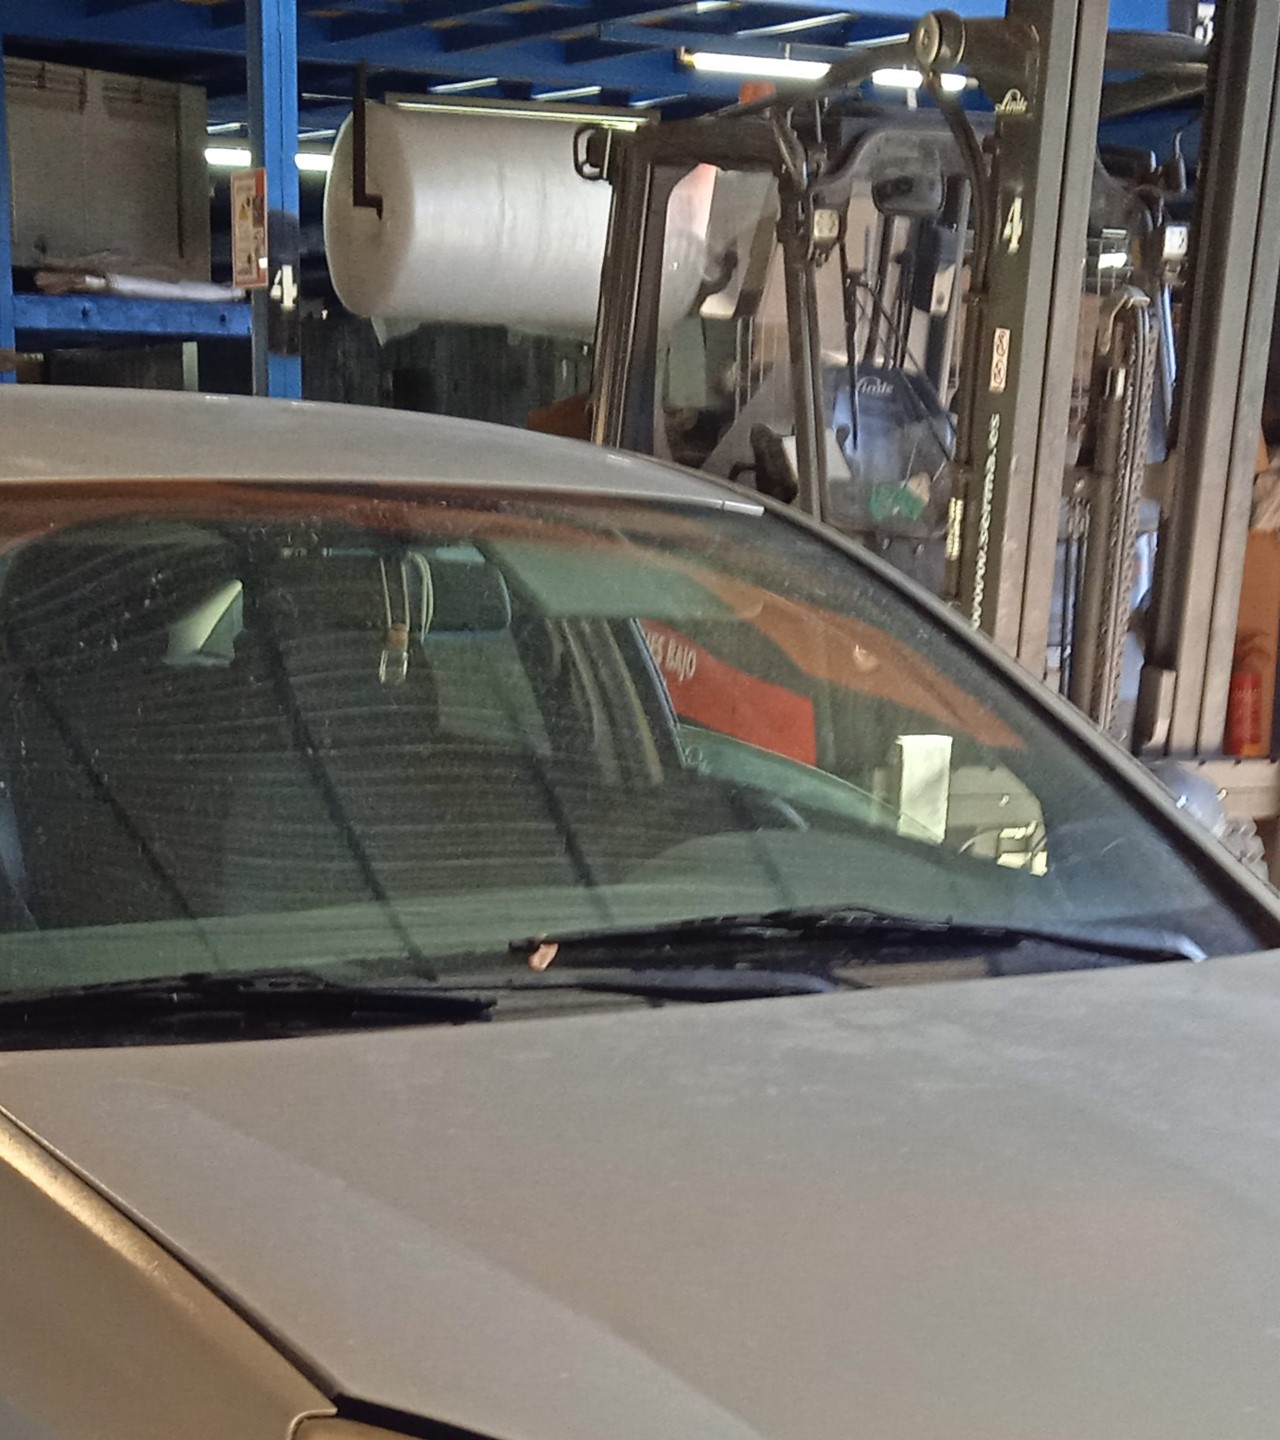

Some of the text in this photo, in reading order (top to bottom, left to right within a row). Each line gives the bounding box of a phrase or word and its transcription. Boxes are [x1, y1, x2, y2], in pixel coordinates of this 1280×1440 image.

[1003, 197, 1023, 254] 4
[270, 265, 297, 311] 4
[971, 413, 1000, 632] www.serma.es
